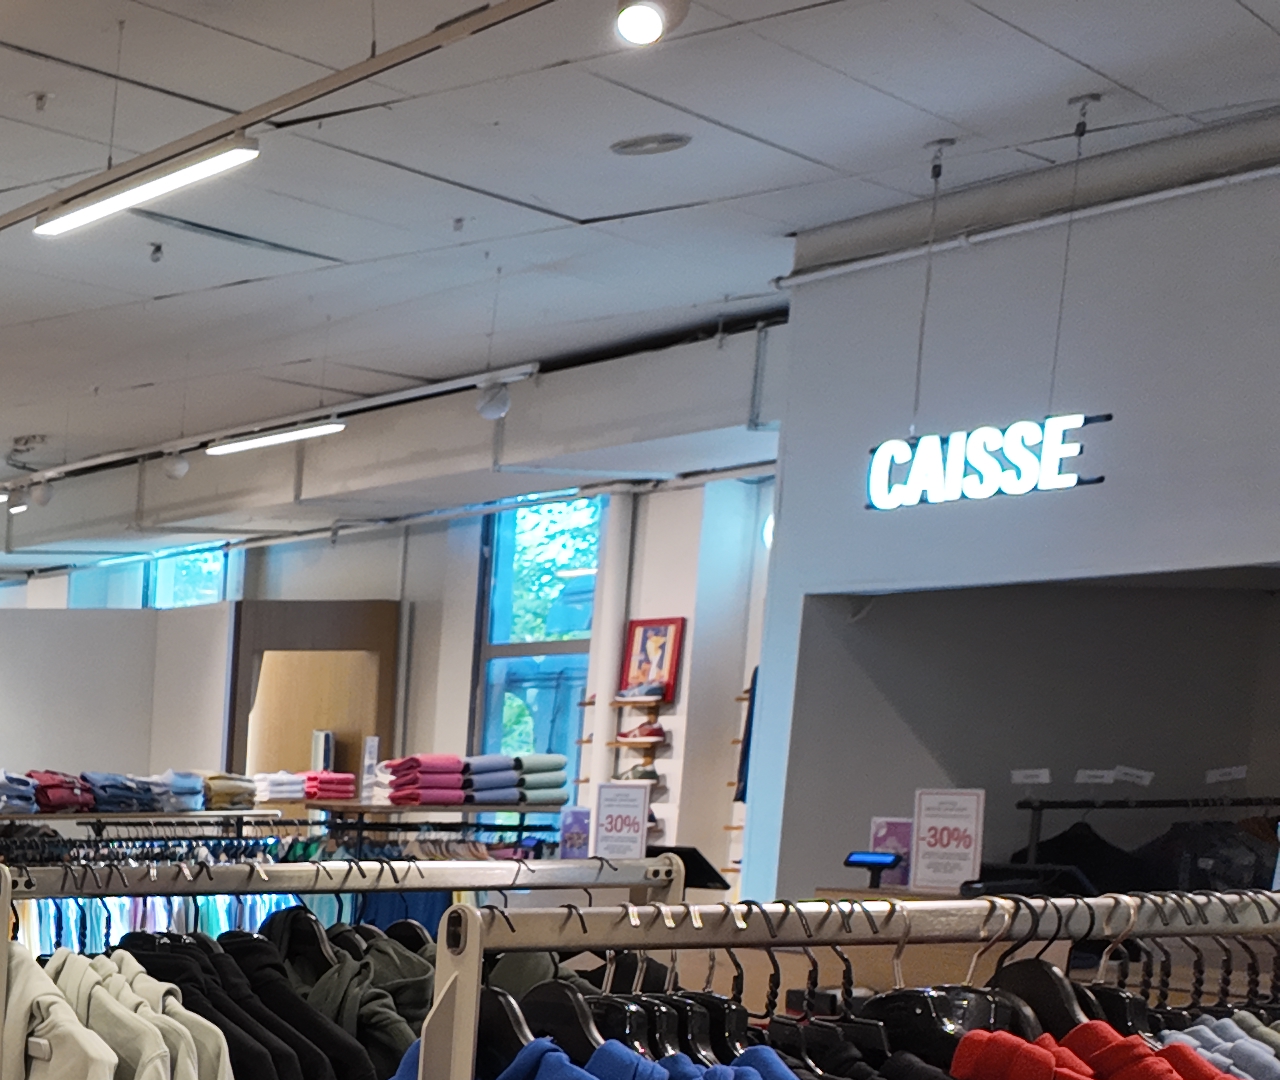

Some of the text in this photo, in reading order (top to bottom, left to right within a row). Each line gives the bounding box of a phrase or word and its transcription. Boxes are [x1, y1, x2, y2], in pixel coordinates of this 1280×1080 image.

[868, 412, 1086, 510] CAISSE
[599, 814, 640, 833] -30%
[920, 826, 972, 849] -30%
